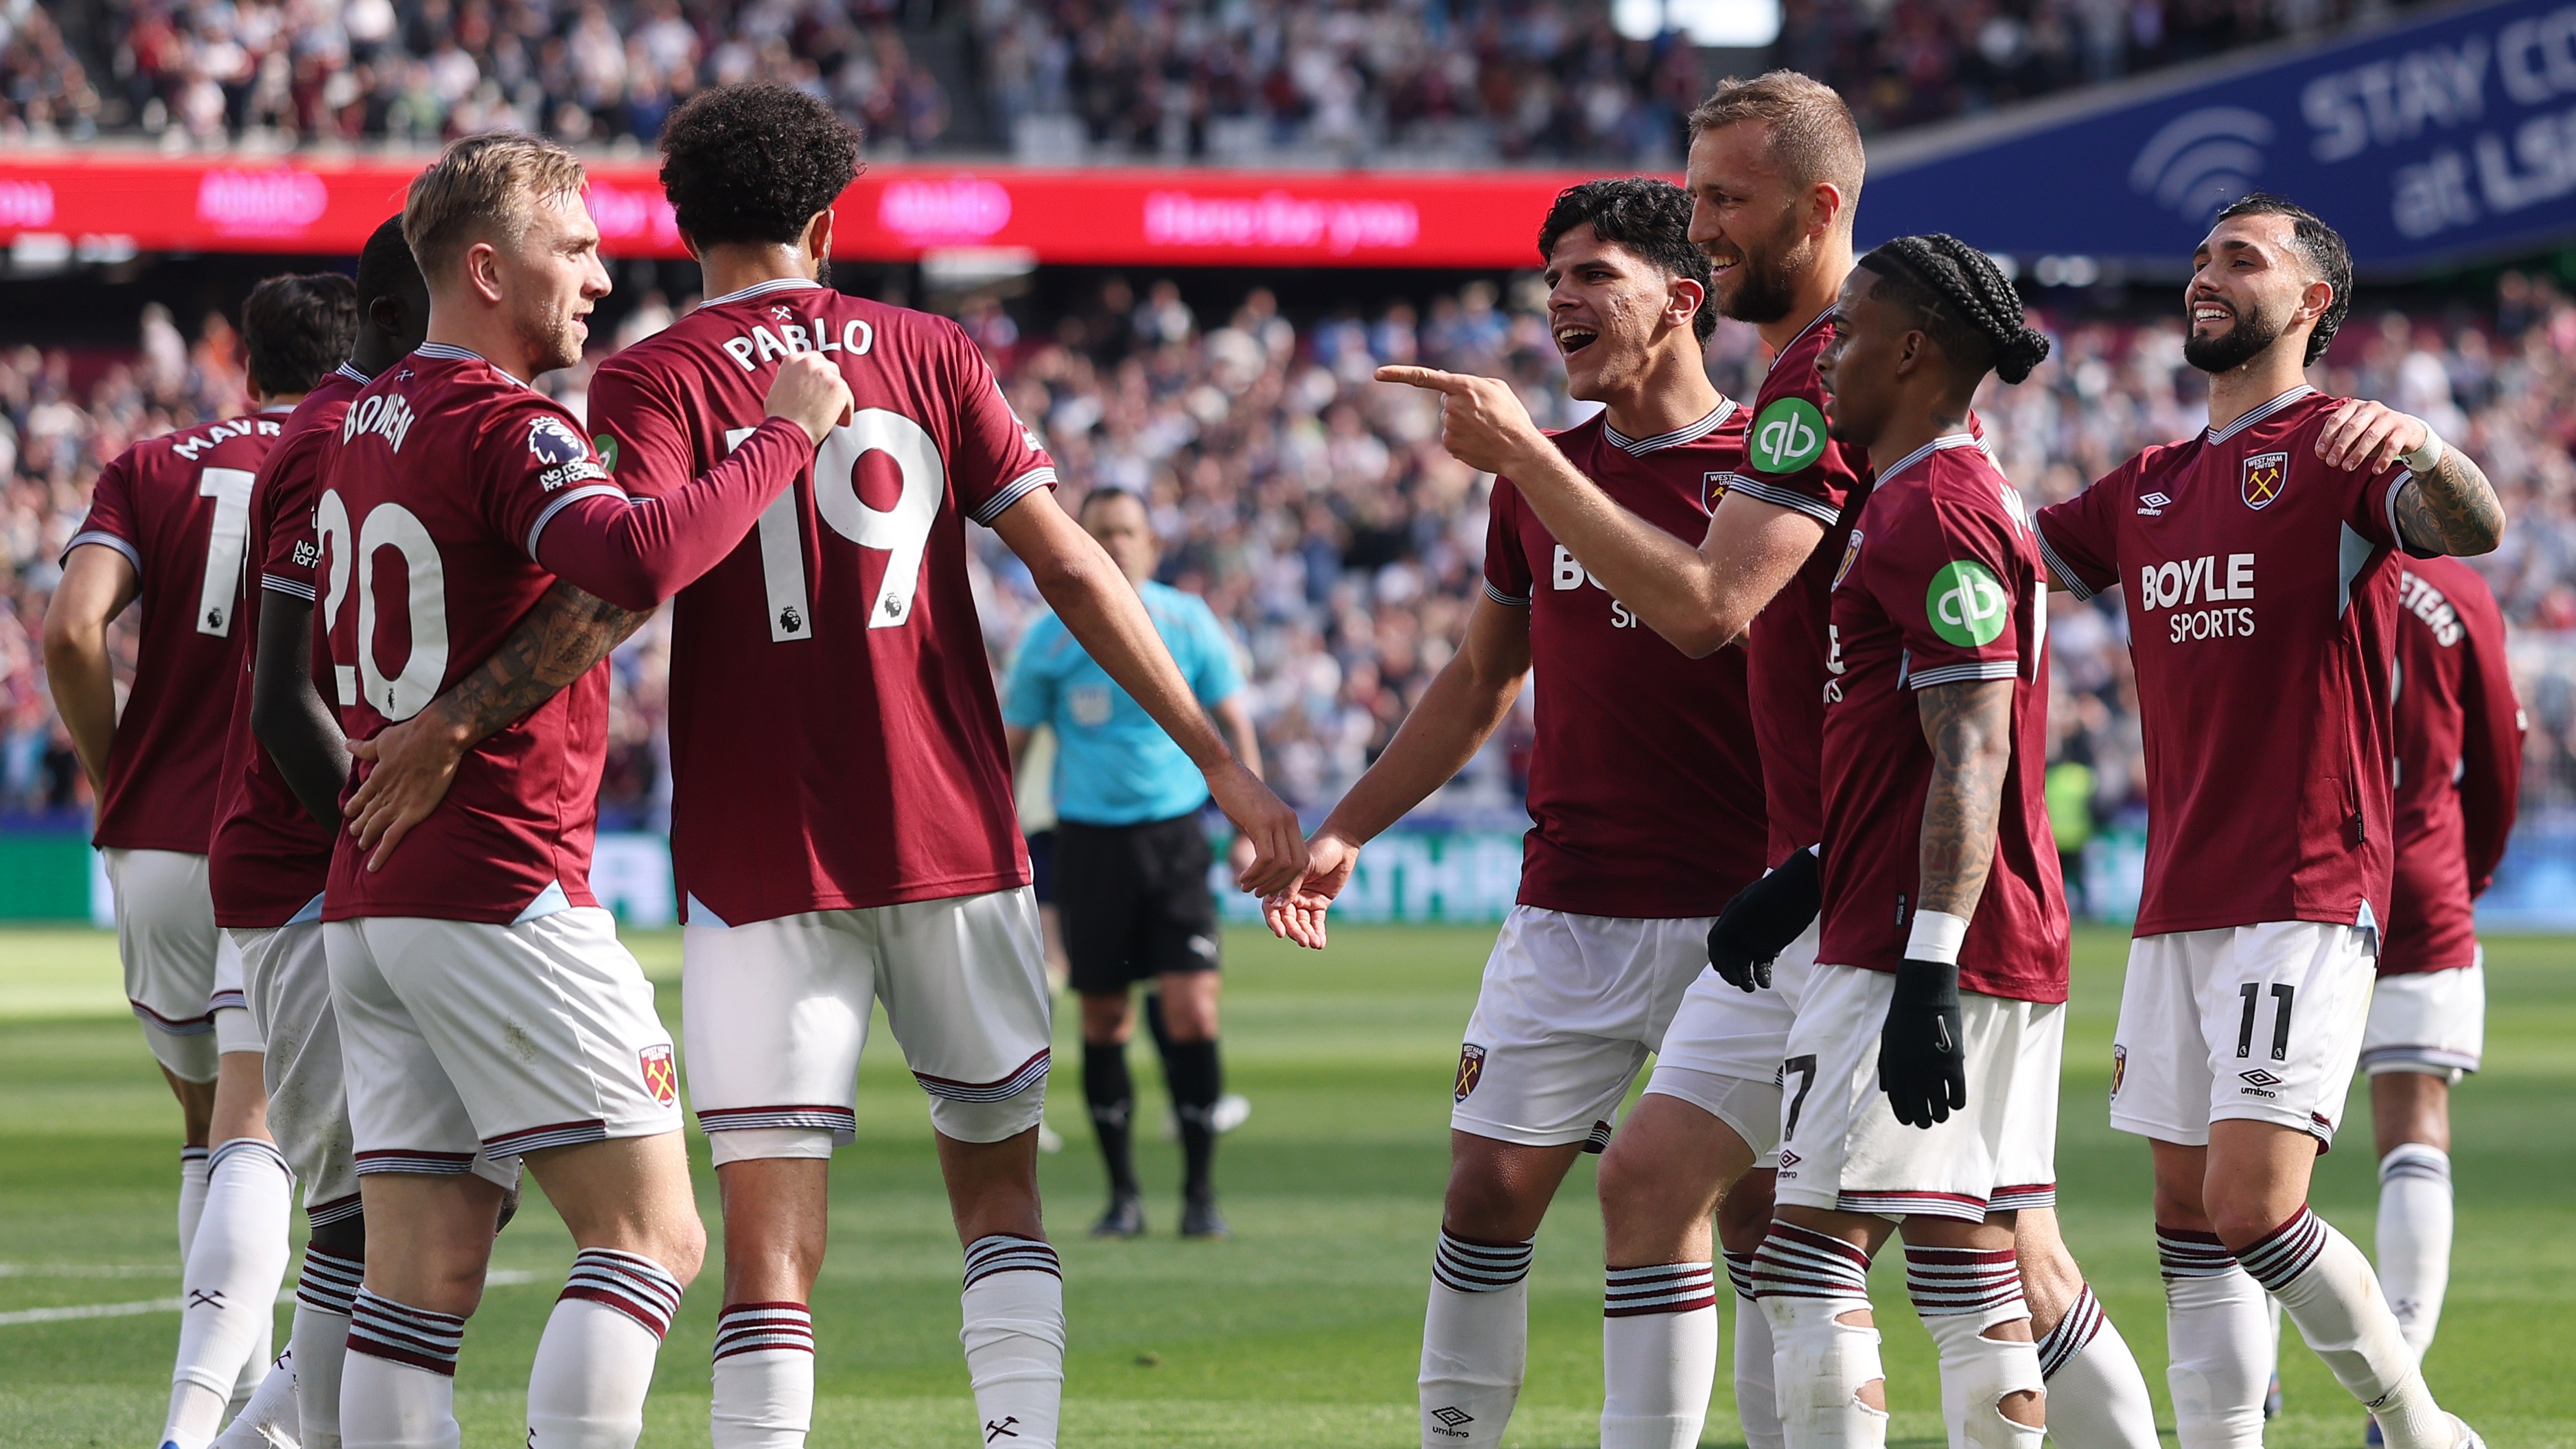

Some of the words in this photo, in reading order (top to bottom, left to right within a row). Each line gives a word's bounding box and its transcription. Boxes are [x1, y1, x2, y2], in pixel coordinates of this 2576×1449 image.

[2302, 38, 2489, 162] STAY
[722, 318, 873, 372] PABLO
[172, 419, 281, 461] MAVR
[343, 393, 415, 454] BOWEN
[725, 407, 944, 643] 19
[2137, 507, 2162, 517] umbro
[199, 467, 257, 638] 1
[292, 551, 312, 567] for
[295, 540, 315, 556] No
[316, 488, 450, 722] 20
[2142, 553, 2255, 612] BOYLE
[2399, 569, 2465, 648] ETERS
[2170, 607, 2255, 644] SPORTS
[2236, 982, 2295, 1061] 11
[1784, 1054, 1818, 1142] 7
[2240, 1087, 2275, 1098] umbro
[1778, 1168, 1798, 1179] mbro
[1432, 1426, 1470, 1439] umbro
